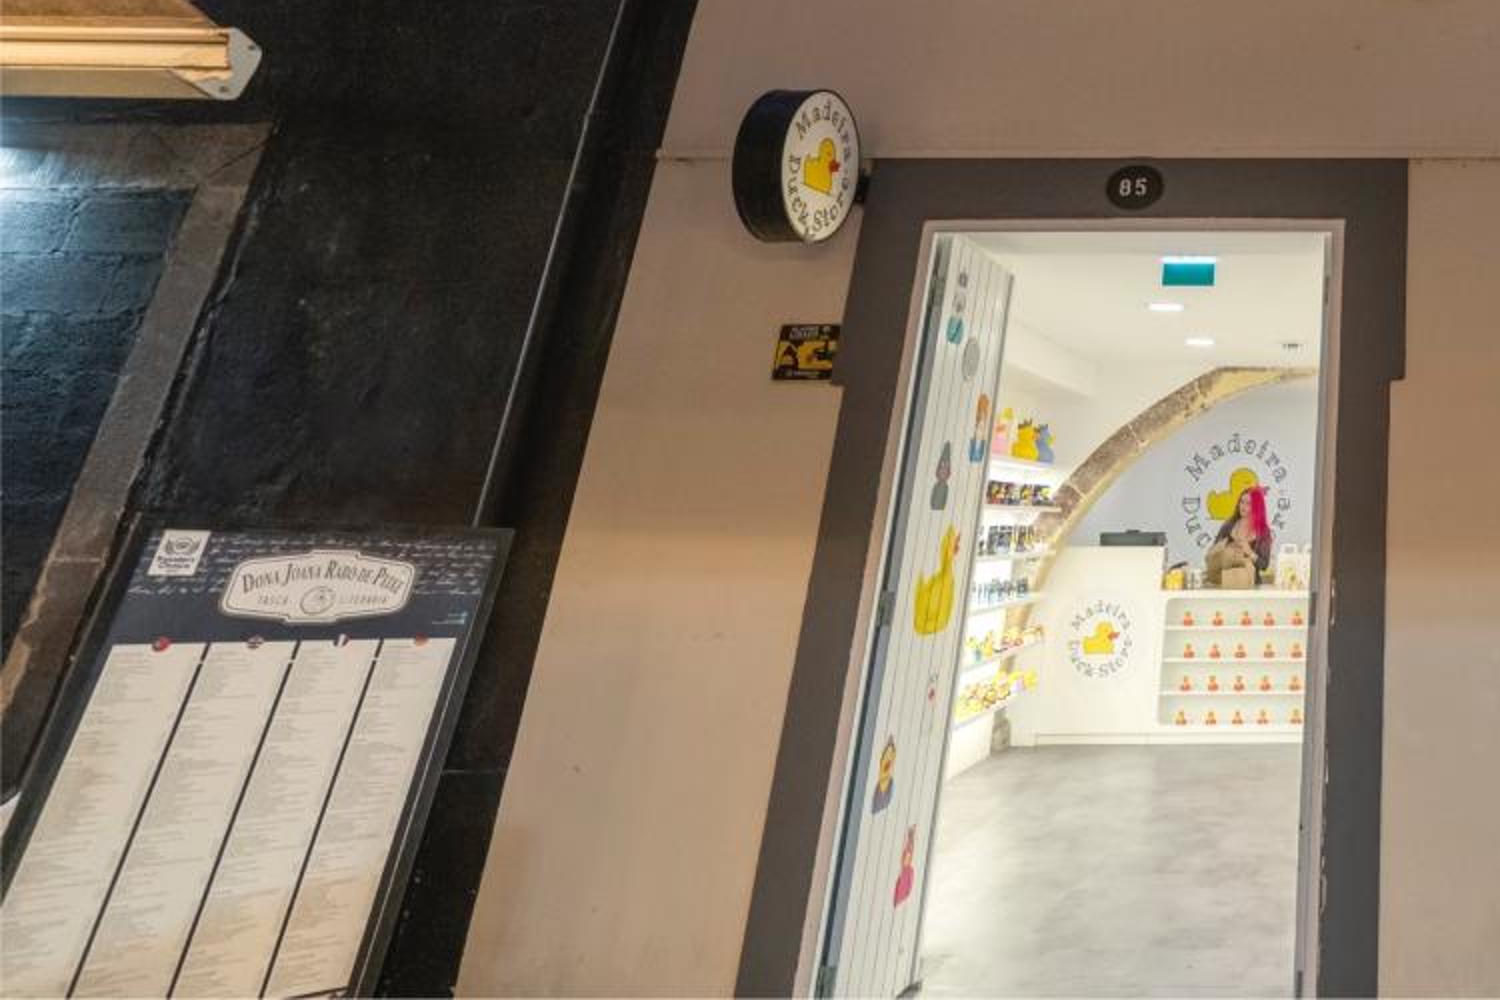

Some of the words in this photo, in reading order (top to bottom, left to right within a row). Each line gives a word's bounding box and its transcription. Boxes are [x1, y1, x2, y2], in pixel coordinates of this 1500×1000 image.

[795, 100, 850, 161] Madeira
[813, 177, 849, 232] Store
[1119, 177, 1147, 197] 85
[1184, 433, 1287, 483] Madeira
[1071, 600, 1130, 630] Madeira
